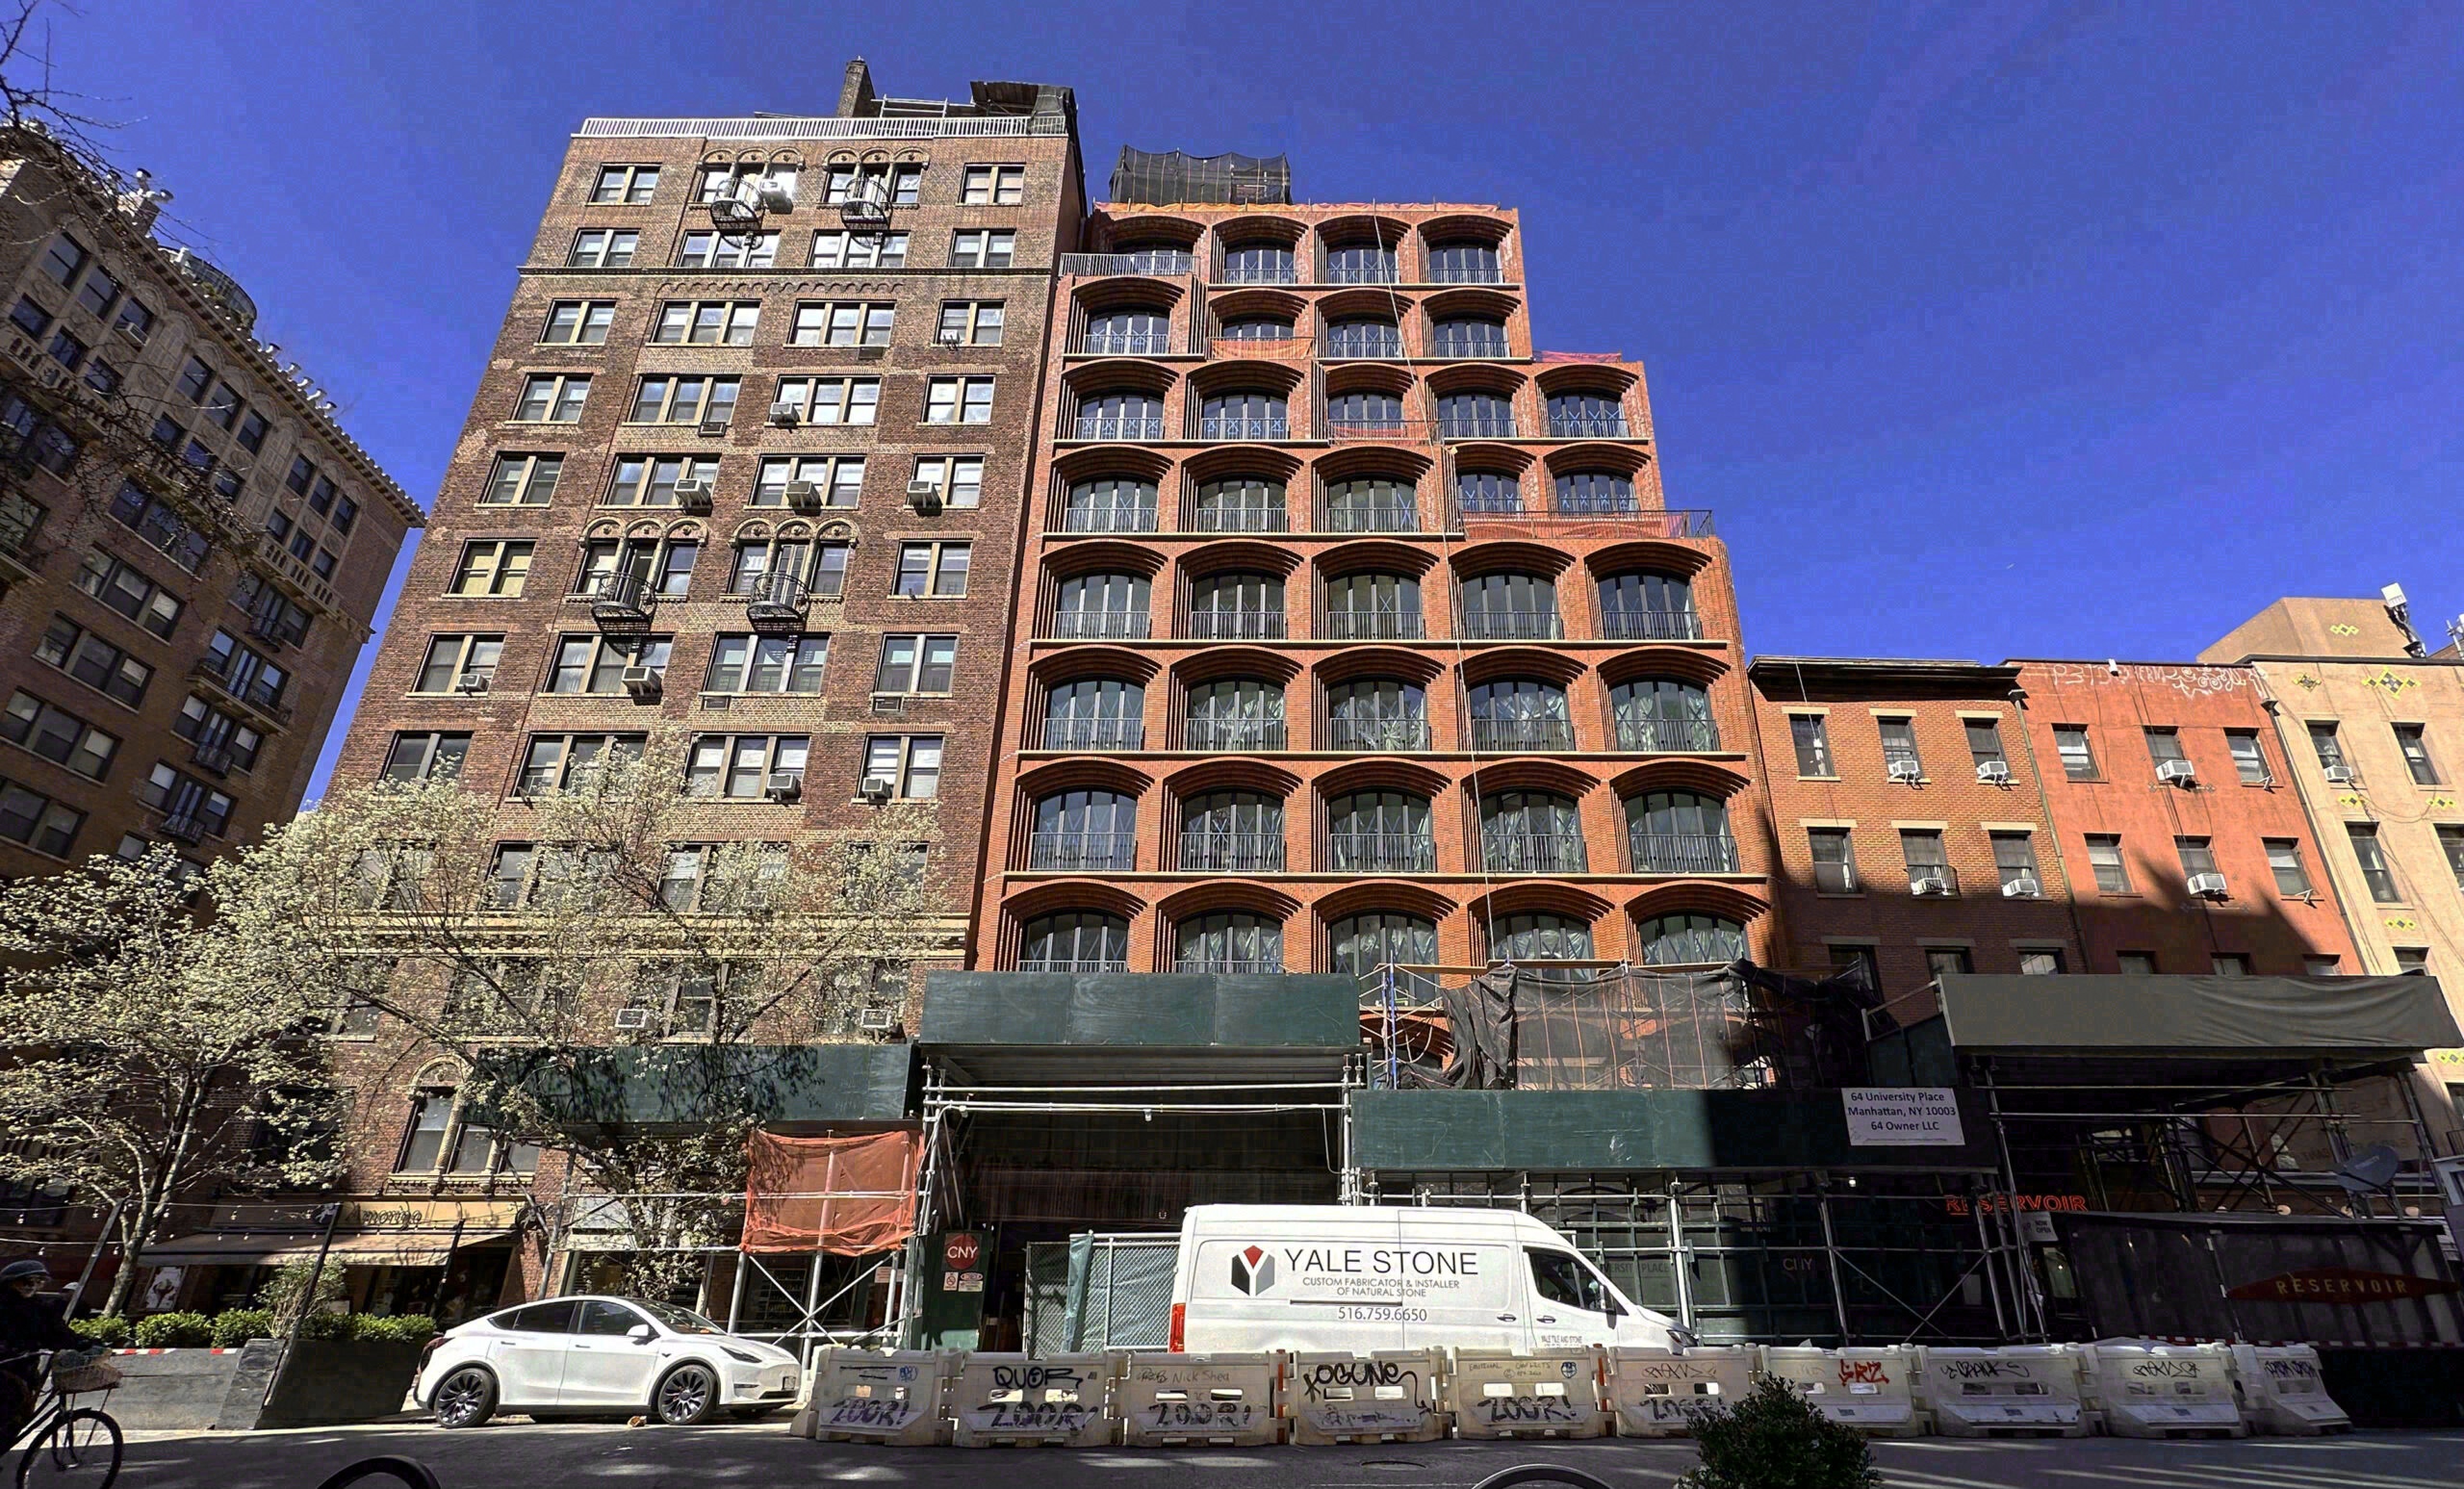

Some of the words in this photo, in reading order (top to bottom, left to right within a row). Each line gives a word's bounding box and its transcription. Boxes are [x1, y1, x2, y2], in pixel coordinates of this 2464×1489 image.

[1851, 1092, 1863, 1102] 64
[1865, 1091, 1915, 1103] University
[1919, 1091, 1945, 1102] Place
[1848, 1106, 1907, 1117] Manhattan,
[1909, 1107, 1923, 1117] NY
[1926, 1107, 1956, 1117] 10003
[1870, 1121, 1884, 1131] 64
[1886, 1121, 1919, 1131] Owner
[1922, 1121, 1940, 1131] LLC
[947, 1245, 978, 1259] CNY
[1284, 1248, 1362, 1272] YALE
[1373, 1250, 1478, 1275] STONE
[1302, 1276, 1343, 1286] CUSTOM
[1345, 1278, 1402, 1288] FABRICATOR
[1405, 1279, 1412, 1288] &
[1415, 1280, 1460, 1289] INSTALLER
[2275, 1277, 2408, 1295] RESERVOIR
[1337, 1287, 1351, 1296] OF
[1352, 1287, 1395, 1296] NATURAL
[1397, 1289, 1427, 1297] STONE
[1338, 1306, 1428, 1322] 516.759.6650
